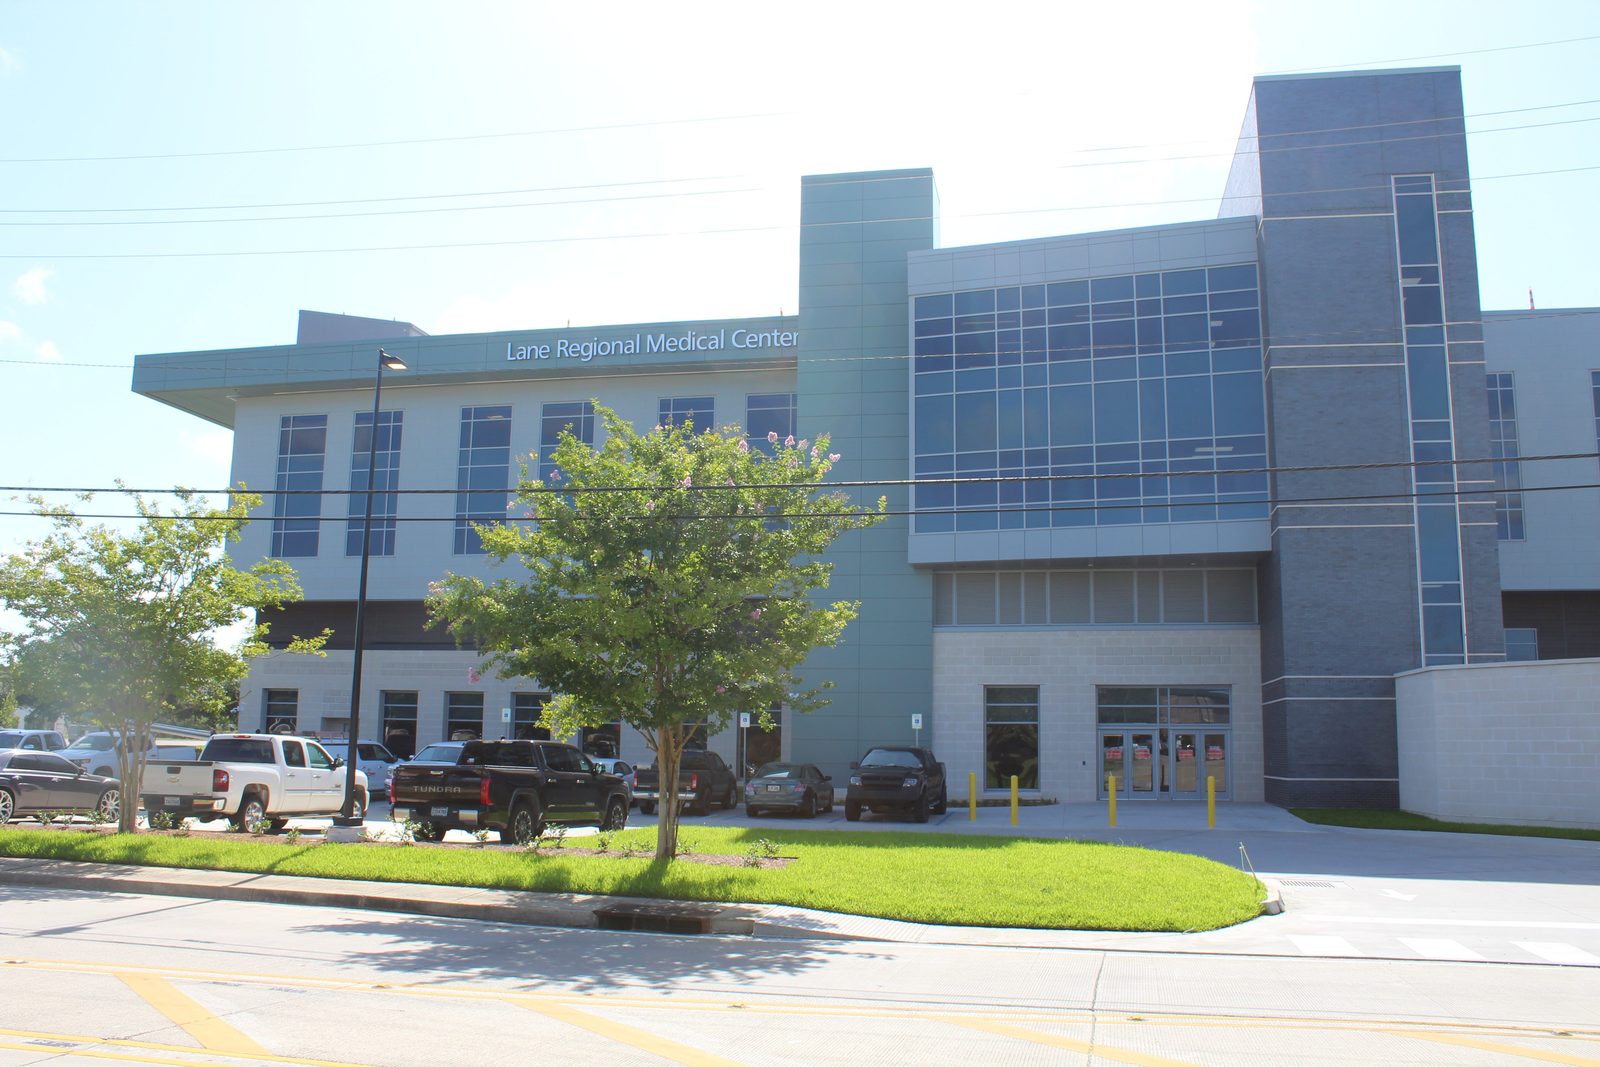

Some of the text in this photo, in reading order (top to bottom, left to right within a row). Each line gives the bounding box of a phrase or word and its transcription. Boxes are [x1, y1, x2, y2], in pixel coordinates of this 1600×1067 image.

[507, 328, 799, 362] Lane Regional Medical Center
[412, 785, 461, 793] TUNDRA
